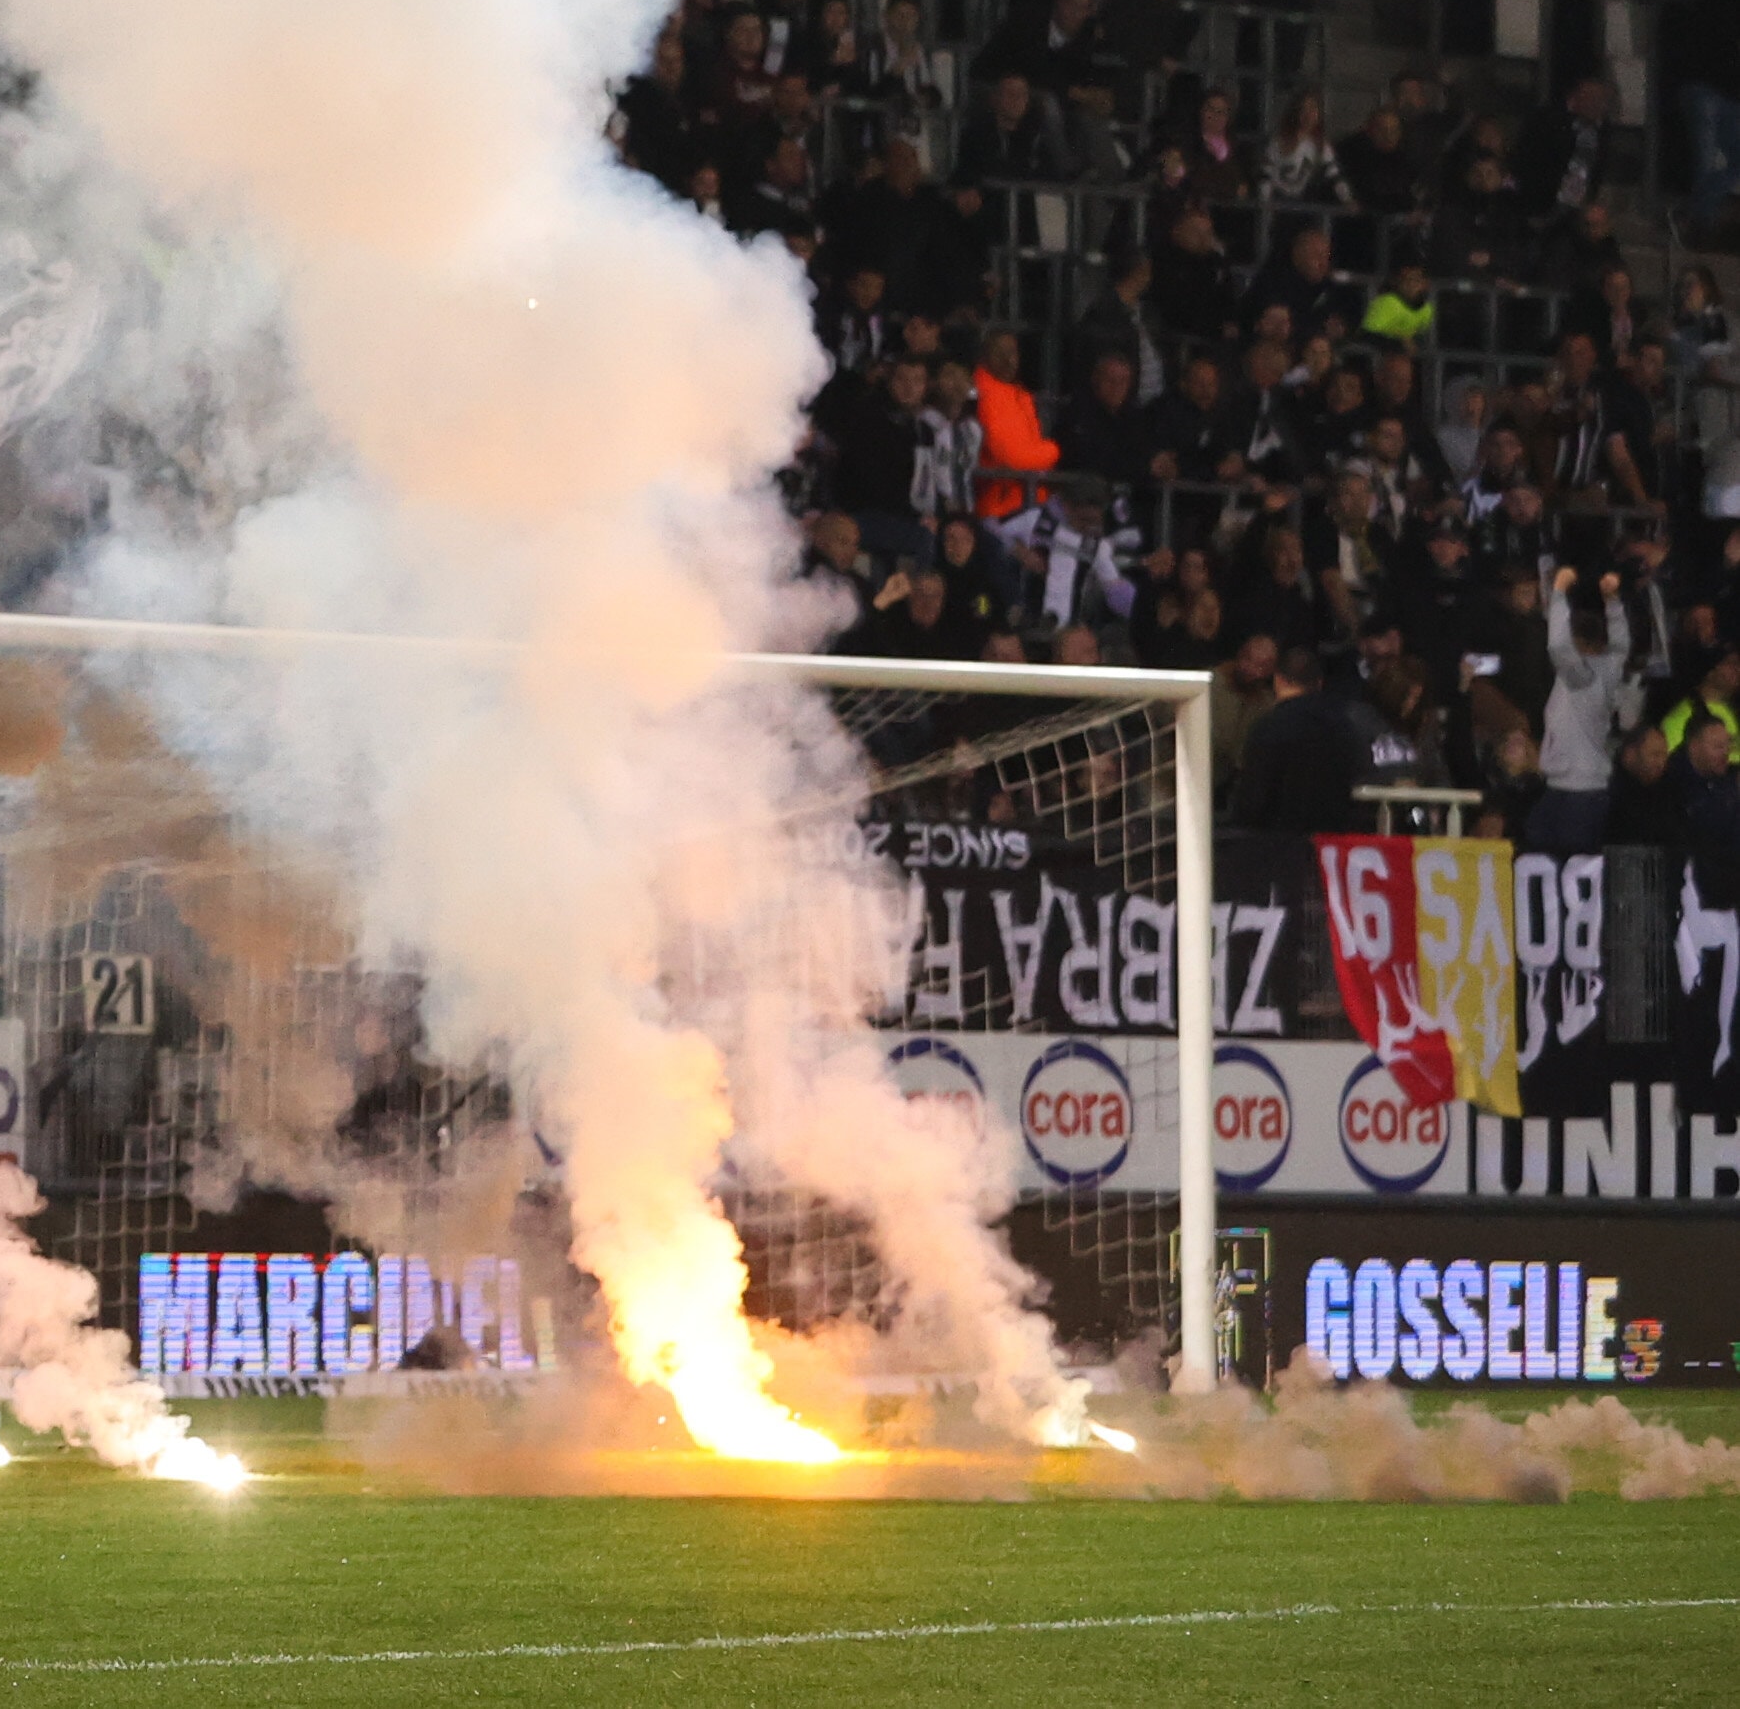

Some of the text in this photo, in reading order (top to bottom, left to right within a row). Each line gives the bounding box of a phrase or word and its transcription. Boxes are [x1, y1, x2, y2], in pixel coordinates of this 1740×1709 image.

[904, 824, 1031, 869] SINCE
[1414, 849, 1605, 969] BOYS
[92, 957, 144, 1028] 21
[1025, 1089, 1125, 1137] cora
[1212, 1093, 1284, 1141] ora
[1344, 1098, 1441, 1145] cora
